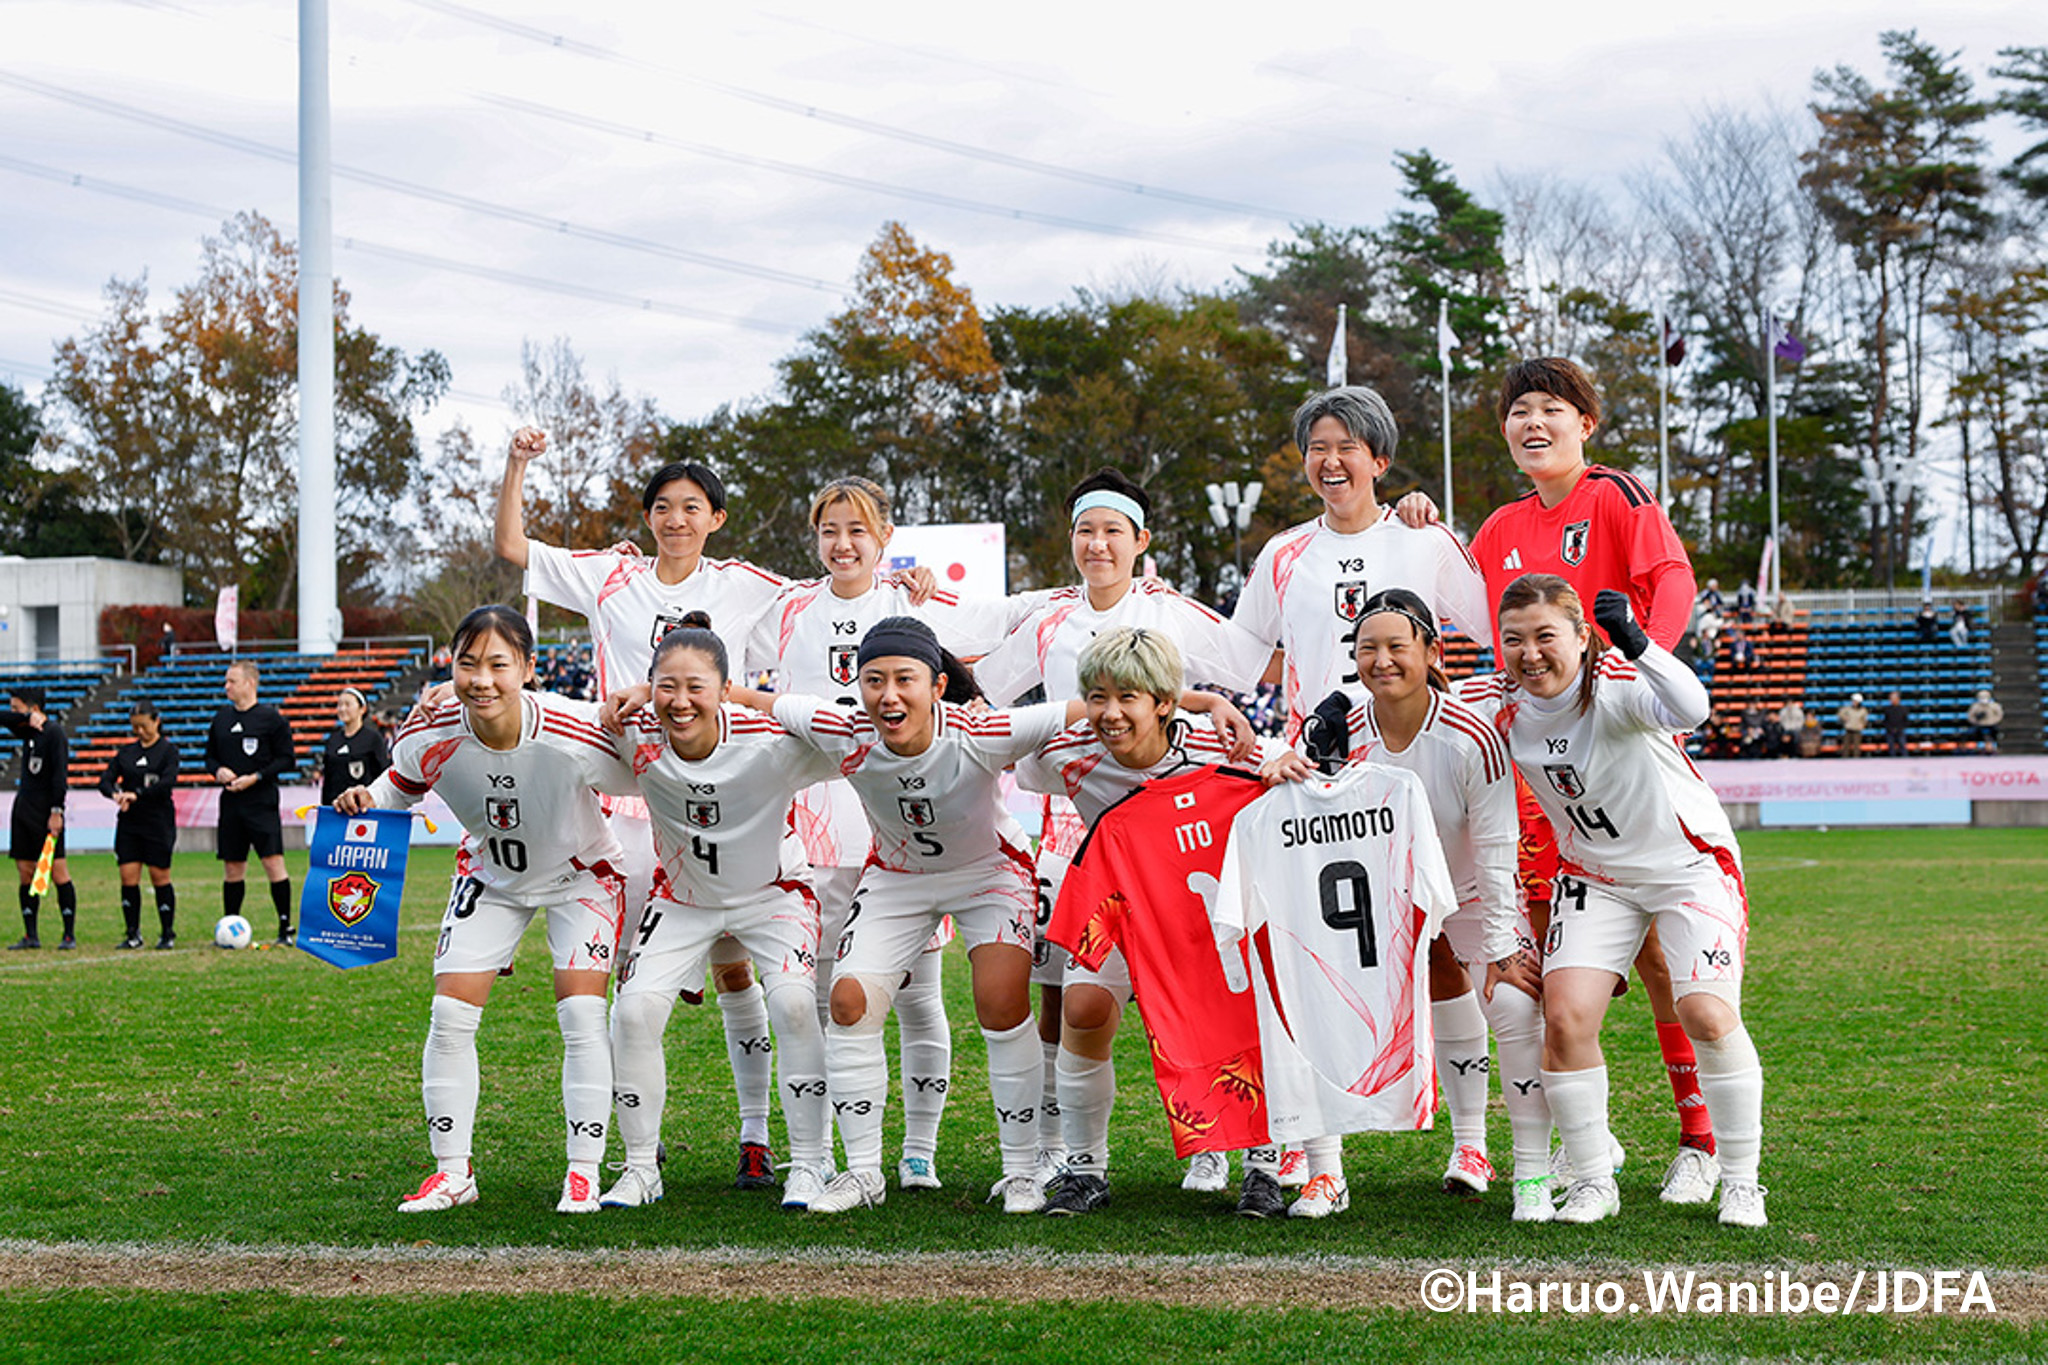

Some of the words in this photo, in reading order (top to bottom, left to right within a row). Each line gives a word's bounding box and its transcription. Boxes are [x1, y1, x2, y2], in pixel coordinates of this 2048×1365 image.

[1338, 558, 1364, 573] Y-3
[832, 621, 857, 635] Y-3
[1546, 739, 1568, 753] Y-3
[487, 774, 516, 788] Y-3
[898, 777, 926, 790] Y-3
[1959, 771, 2040, 787] TOYOTA
[688, 784, 715, 795] Y-3
[1282, 807, 1394, 848] SUGIMOTO
[1565, 805, 1620, 841] 14
[913, 832, 944, 857] 5
[1175, 821, 1213, 853] ITO
[327, 845, 389, 869] JAPAN
[489, 837, 528, 873] 10
[692, 836, 719, 875] 4
[1553, 875, 1588, 918] 14
[1319, 860, 1378, 968] 9
[638, 905, 663, 945] 4
[585, 943, 609, 958] Y-3
[1703, 950, 1731, 966] Y-3
[739, 1037, 772, 1055] Y-3
[1449, 1056, 1489, 1076] Y-3
[788, 1081, 827, 1098] Y-3
[911, 1077, 947, 1093] Y-3
[1513, 1080, 1540, 1095] Y-
[832, 1101, 872, 1115] Y-3
[997, 1107, 1034, 1123] Y-3
[569, 1120, 604, 1138] Y-3
